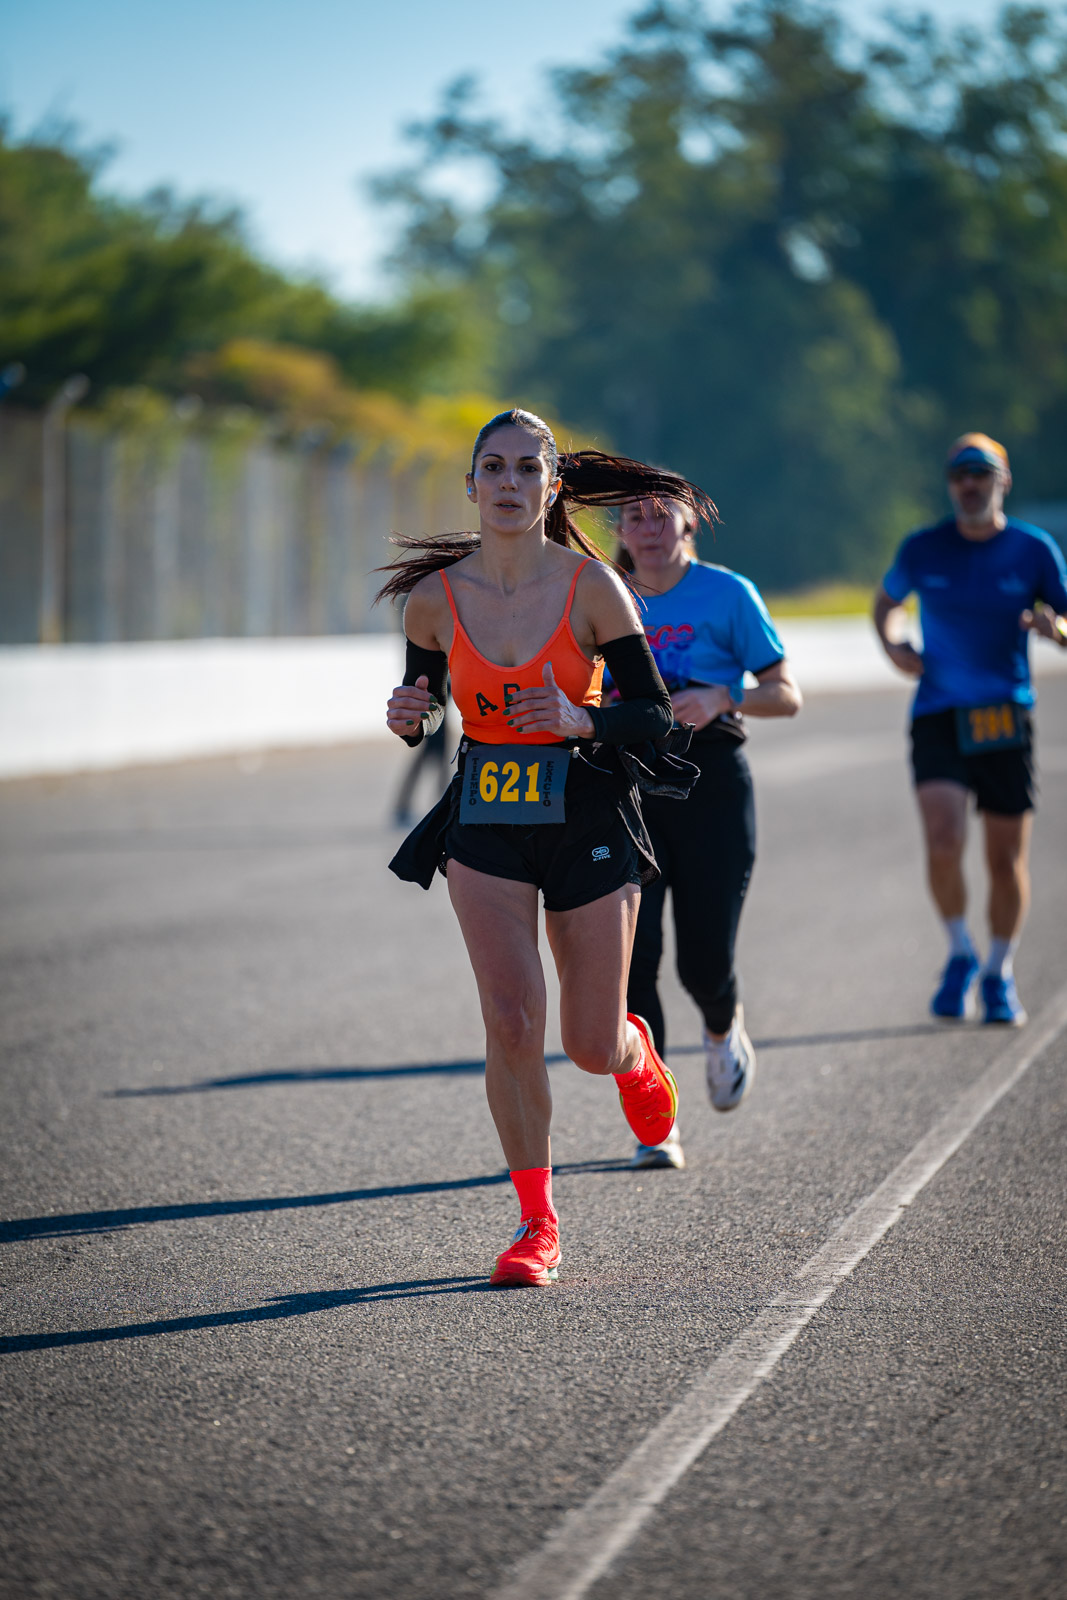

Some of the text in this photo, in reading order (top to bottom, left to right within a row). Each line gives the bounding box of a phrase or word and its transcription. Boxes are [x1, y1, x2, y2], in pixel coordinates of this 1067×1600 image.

[468, 757, 479, 806] TIEMPO
[479, 761, 540, 802] 621
[543, 760, 554, 807] EXACTO
